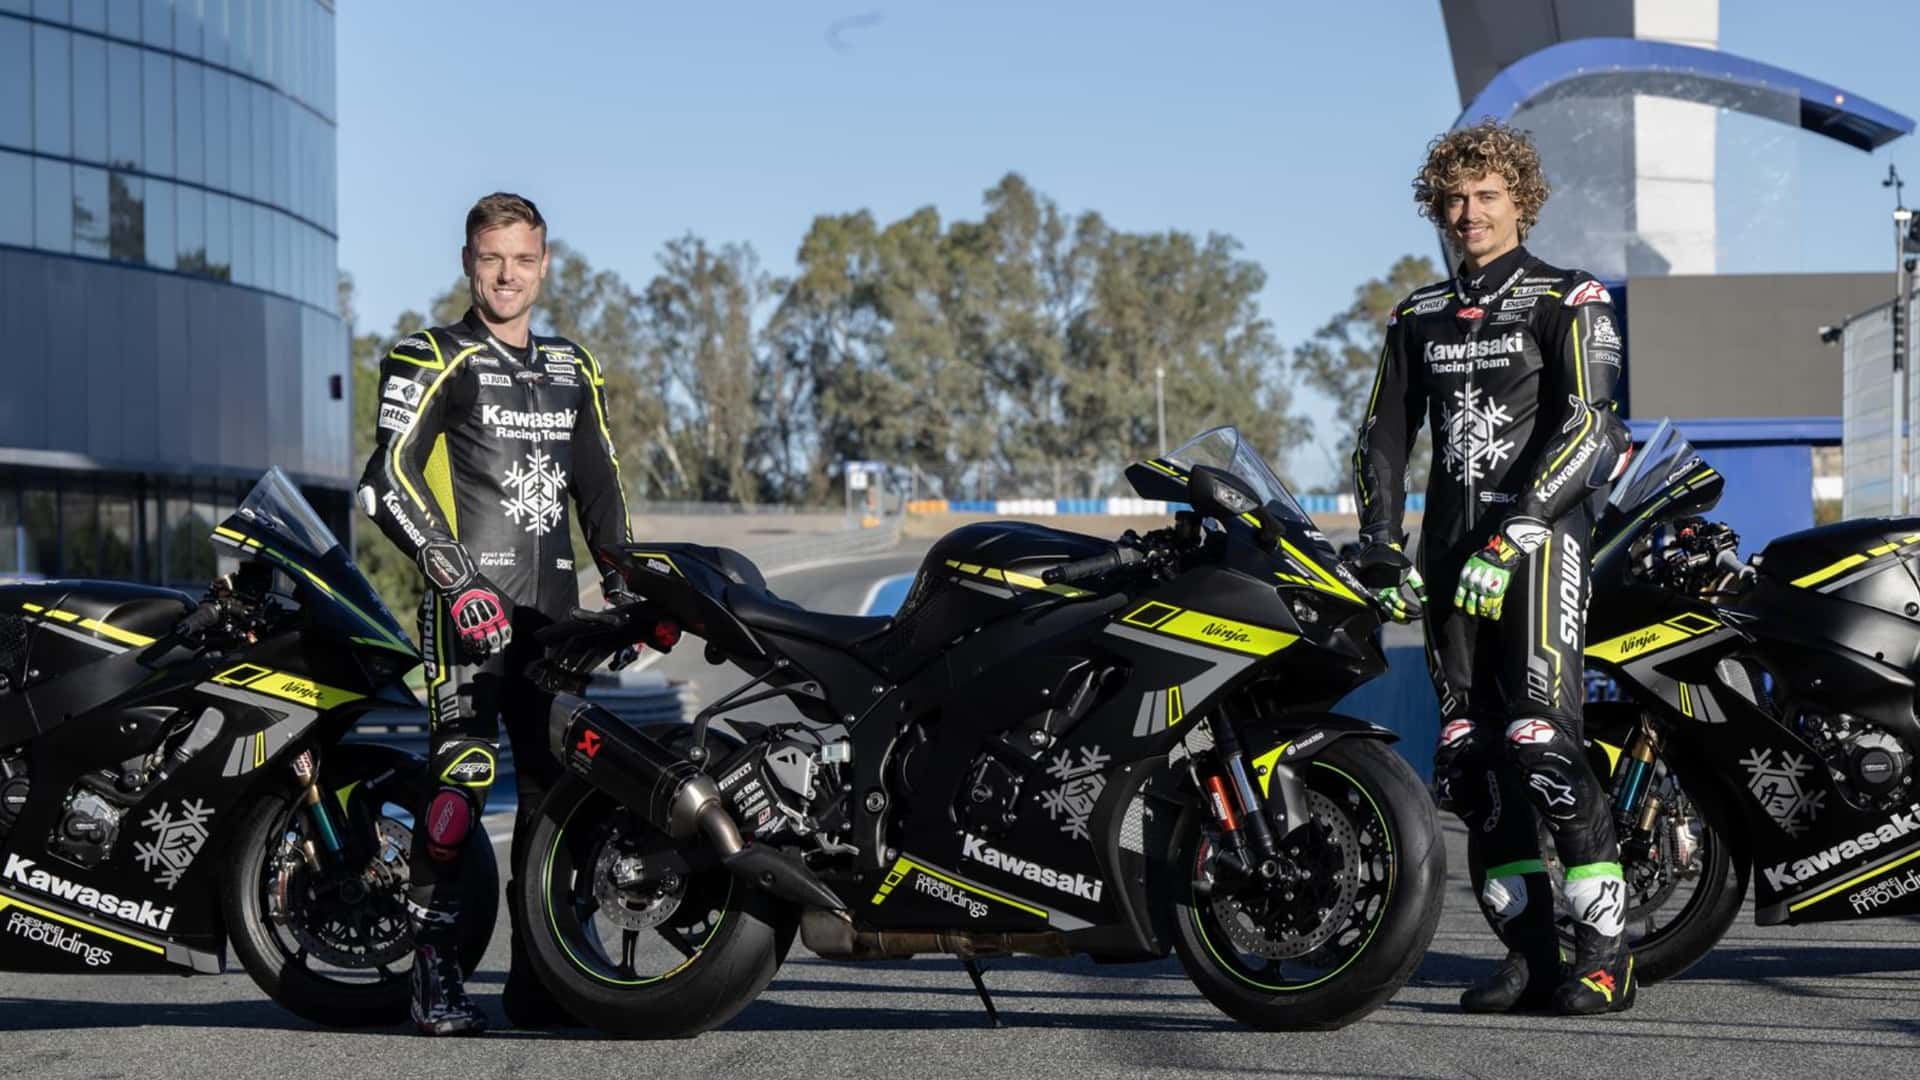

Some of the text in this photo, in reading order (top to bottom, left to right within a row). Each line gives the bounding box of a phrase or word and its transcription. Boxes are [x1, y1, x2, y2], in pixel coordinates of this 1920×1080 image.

[1420, 299, 1445, 310] SHOEI
[1424, 332, 1523, 363] Kawasaki
[1432, 357, 1510, 374] Racing Team
[382, 408, 411, 424] attis
[496, 427, 571, 442] Racing Team
[1536, 432, 1598, 503] Kawasaki
[1480, 491, 1518, 503] SBK
[382, 490, 426, 548] Kawasa
[1560, 533, 1581, 651] SHOWA
[1201, 622, 1251, 642] Ninja
[1620, 631, 1661, 654] Ninja
[281, 681, 324, 700] Ninja
[450, 762, 491, 776] RST
[718, 762, 752, 791] PIRELLI
[1763, 803, 1920, 892] Kawasaki
[962, 833, 1103, 902] Kawasaki
[3, 853, 174, 931] Kawasaki
[915, 878, 989, 918] mouldings
[1849, 877, 1897, 902] CHESHIRE
[1853, 869, 1920, 914] mouldi
[11, 912, 61, 934] CHESHIRE
[407, 898, 460, 924] TCX
[6, 919, 113, 966] mouldings
